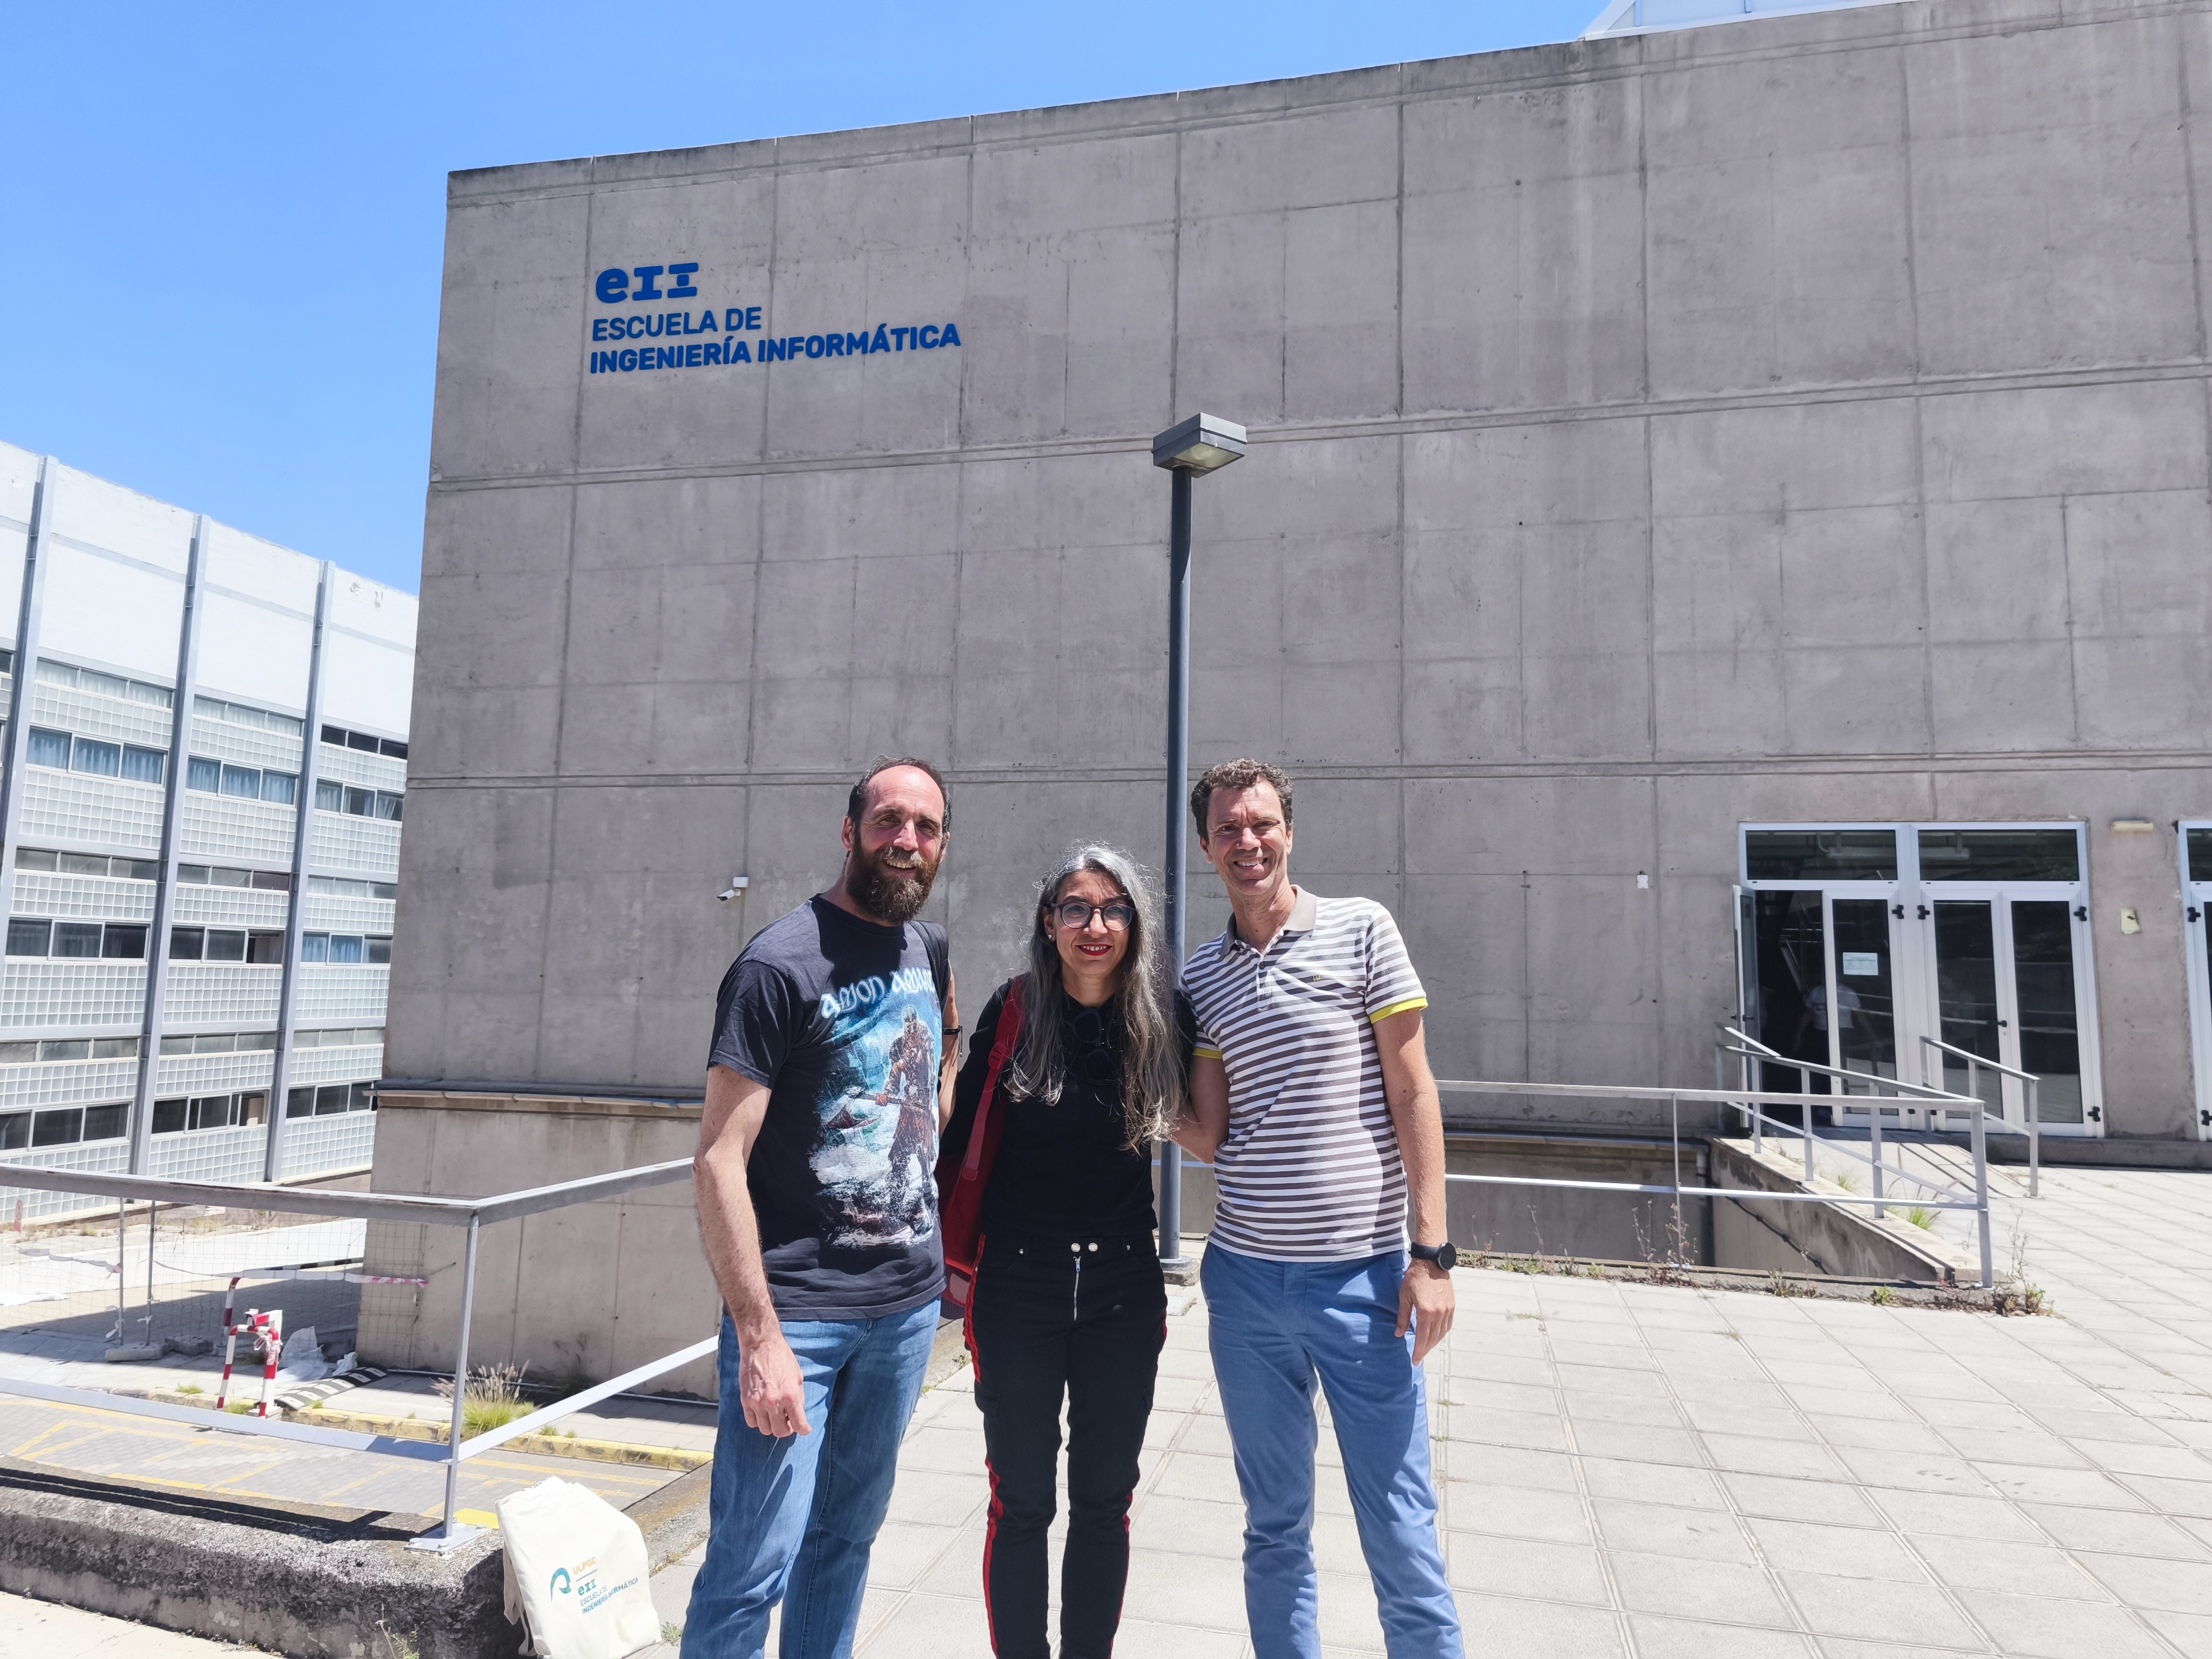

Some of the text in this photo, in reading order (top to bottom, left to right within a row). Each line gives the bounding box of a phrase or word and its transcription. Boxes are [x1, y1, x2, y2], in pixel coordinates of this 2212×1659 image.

[592, 306, 761, 341] ESCUELA DE
[590, 323, 961, 374] INGENIERÍA INFORMÁTICA
[573, 1556, 597, 1575] ULPGC
[580, 1585, 608, 1606] ESCUELA DE
[582, 1594, 608, 1615] INGENIERÍA
